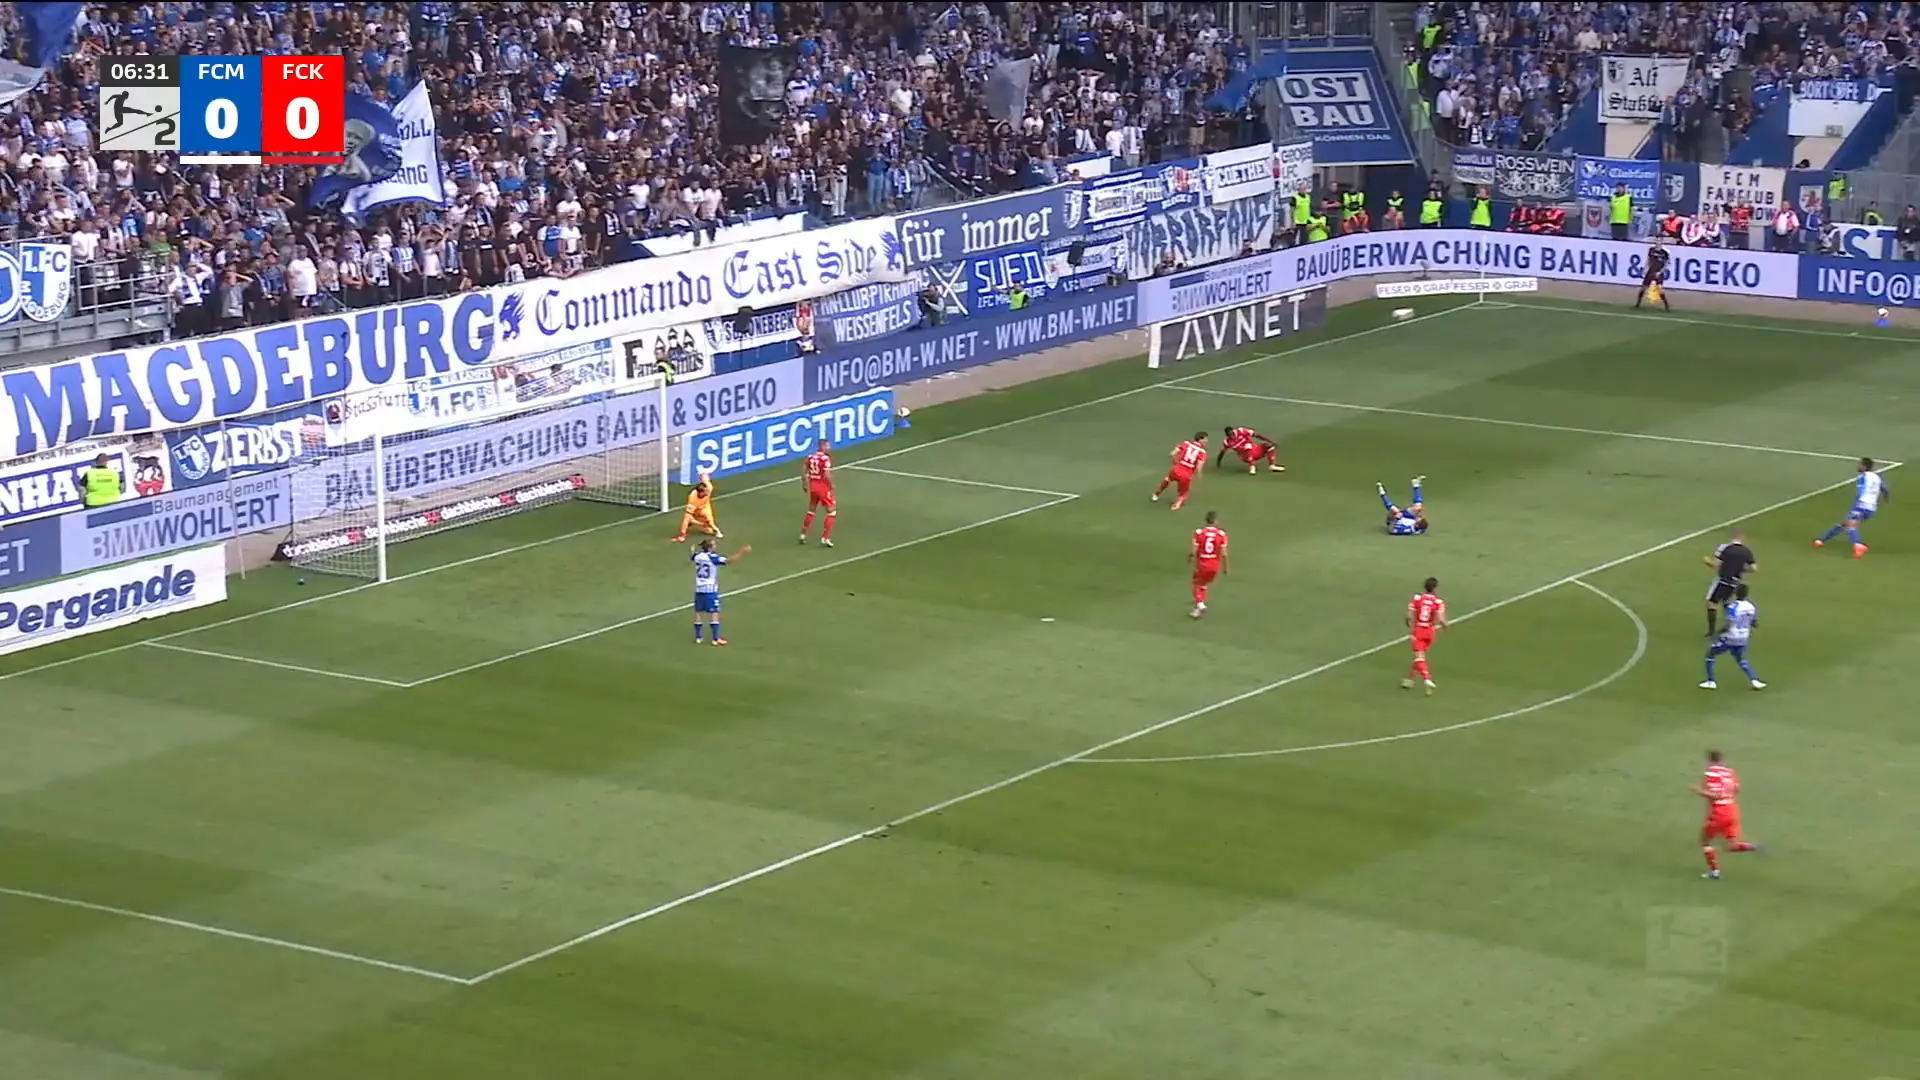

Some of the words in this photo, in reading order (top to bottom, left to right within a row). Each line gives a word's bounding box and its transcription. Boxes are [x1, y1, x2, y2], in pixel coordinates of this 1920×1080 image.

[1284, 77, 1359, 99] OST
[1289, 104, 1375, 127] BAU
[1496, 154, 1575, 173] ROSSWEIN
[902, 219, 945, 266] für
[961, 205, 1053, 254] immer
[1296, 239, 1530, 282] BAUÜBERWACHUNG
[1540, 246, 1618, 282] BAHN
[535, 270, 713, 336] Commando
[723, 249, 808, 299] East
[816, 240, 877, 283] Side
[1378, 284, 1411, 296] FESER
[1453, 281, 1490, 292] FESER
[1504, 280, 1536, 290] GRAF
[817, 331, 979, 393] INFO@BM-W.NET
[995, 295, 1135, 350] WWW.BM-W.NET
[833, 300, 912, 343] WEISSENFELS
[3, 293, 495, 455] MAGDEBURG
[597, 403, 662, 445] BAHN
[673, 397, 687, 427] &
[694, 377, 778, 421] SIGEKO
[697, 398, 890, 474] SELECTRIC
[203, 417, 304, 474] ZERBST
[154, 477, 279, 515] Baumanagement
[0, 563, 196, 634] Pergande
